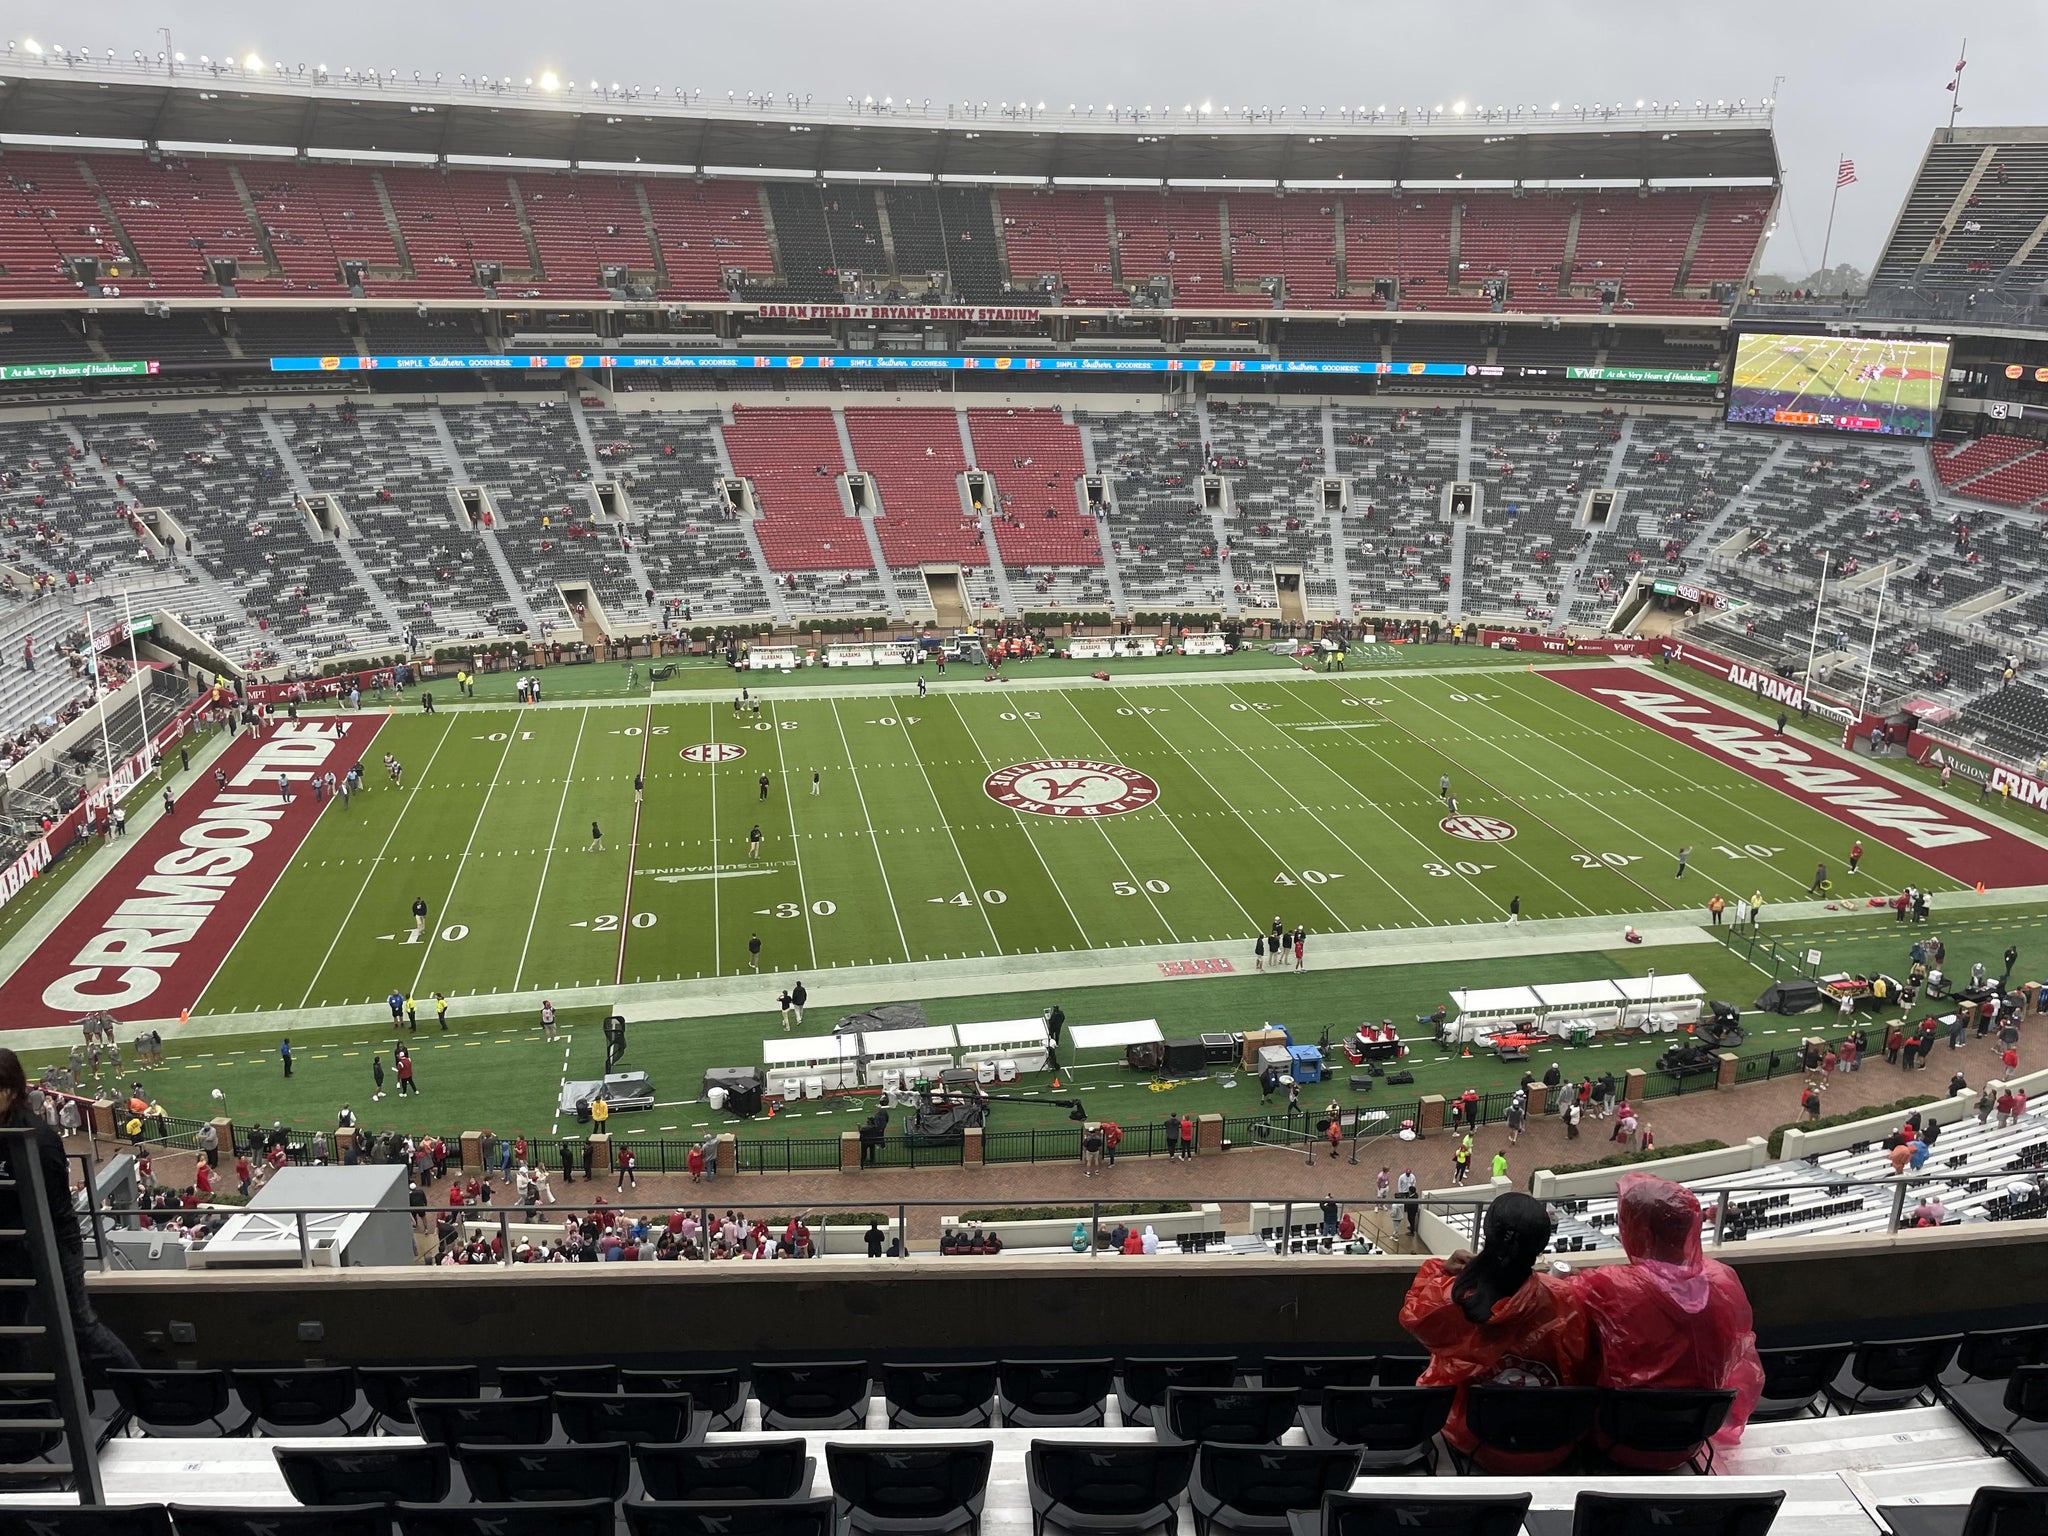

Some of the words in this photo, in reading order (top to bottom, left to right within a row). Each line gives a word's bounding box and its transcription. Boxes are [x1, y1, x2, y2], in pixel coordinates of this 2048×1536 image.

[759, 305, 803, 318] SABAN
[811, 306, 850, 318] FIELD
[854, 308, 868, 317] AT
[871, 307, 976, 320] BRYANT-DENNY
[978, 308, 1039, 320] STADIUM
[24, 368, 36, 376] the
[38, 367, 56, 378] Very
[58, 366, 80, 375] Heart
[81, 364, 91, 377] of
[1628, 371, 1642, 381] Very
[1644, 372, 1663, 380] Heart
[1993, 405, 2006, 417] 25
[1715, 595, 1726, 609] 25
[1543, 640, 1565, 651] YETI
[999, 711, 1042, 721] 50
[488, 731, 536, 743] 10
[624, 725, 670, 737] 20
[681, 743, 746, 763] SEC
[1031, 761, 1143, 780] CRIMSON
[1592, 687, 1992, 849] ALABAMA
[1947, 754, 1990, 780] REGIONS
[989, 767, 1031, 787] TIDE
[999, 787, 1153, 815] ALABAMA
[1443, 816, 1512, 841] SEC
[1570, 852, 1630, 869] 20
[1711, 843, 1774, 860] 10
[42, 793, 298, 1012] CRIMSON
[228, 721, 353, 787] TIDE
[1422, 860, 1482, 878] 30
[1273, 868, 1329, 887] 40
[1111, 878, 1171, 897] 50
[949, 889, 1008, 908] 40
[775, 899, 838, 920] 30
[592, 911, 659, 933] 20
[398, 923, 470, 945] 10
